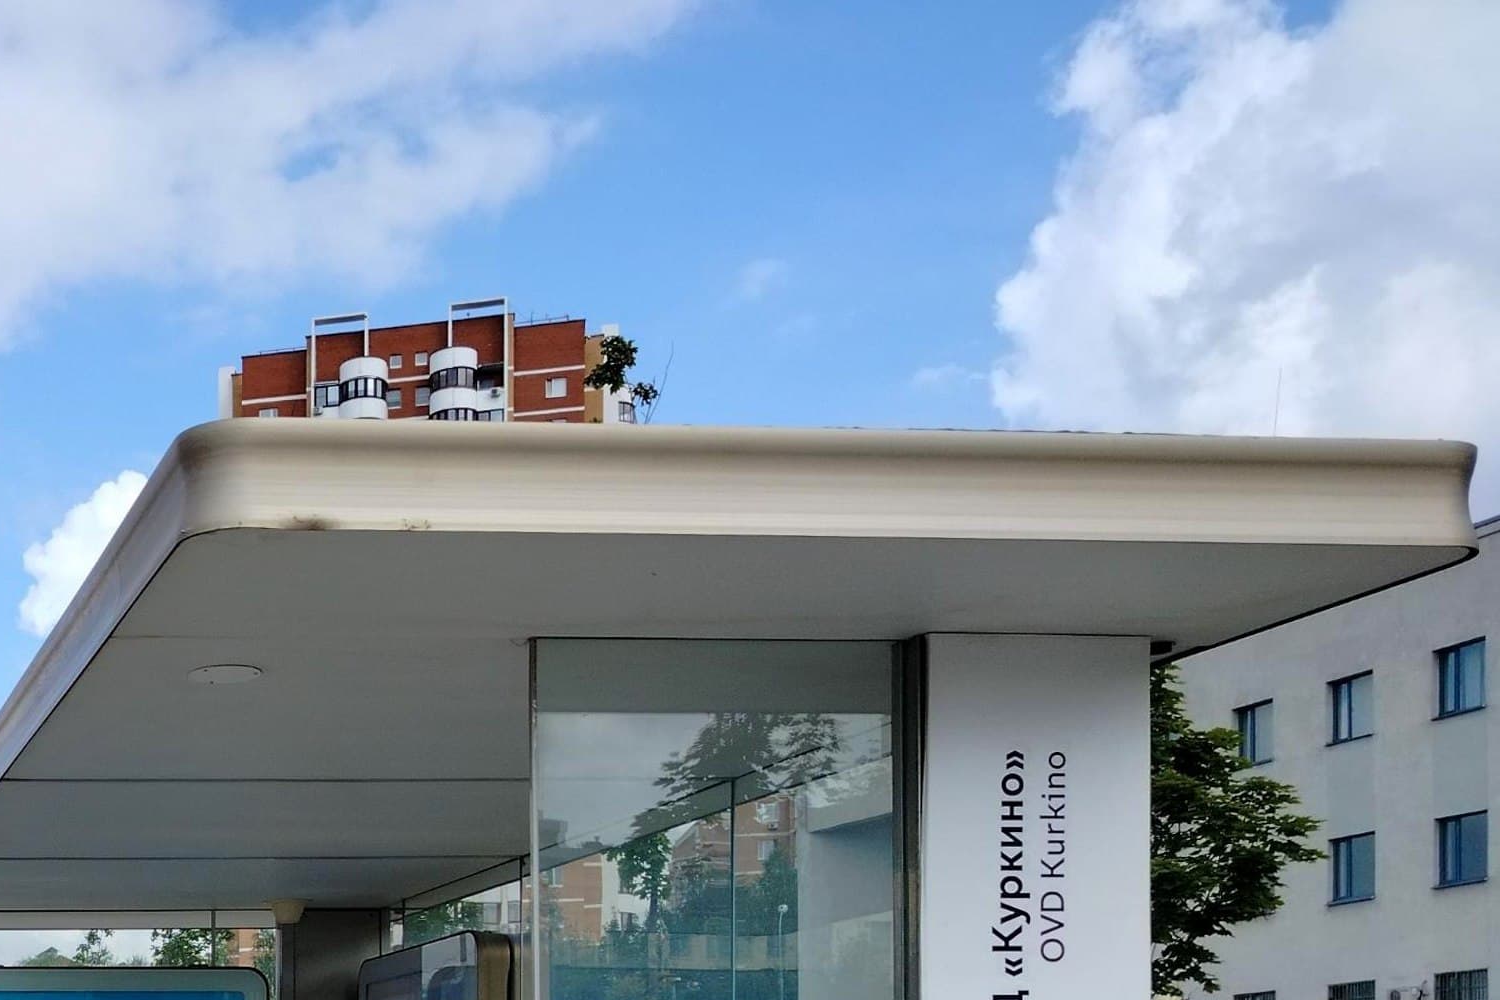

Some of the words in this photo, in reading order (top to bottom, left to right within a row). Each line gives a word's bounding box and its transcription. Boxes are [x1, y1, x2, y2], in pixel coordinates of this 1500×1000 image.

[992, 750, 1030, 976] «Куркино»
[1040, 751, 1066, 878] Kurkino
[1040, 891, 1066, 963] OVD
